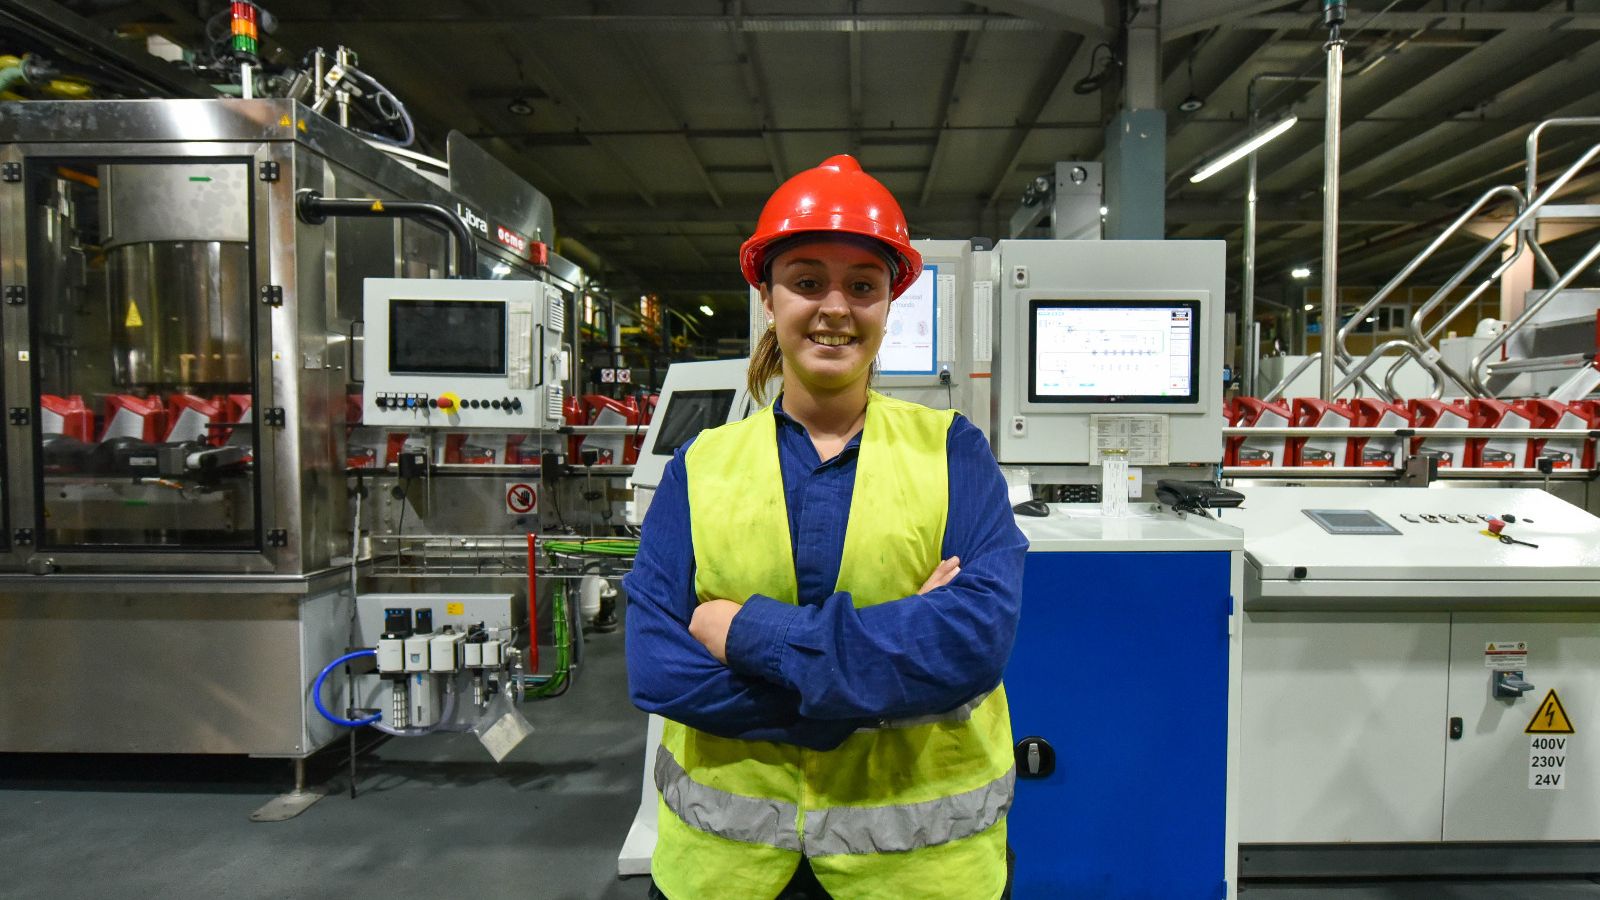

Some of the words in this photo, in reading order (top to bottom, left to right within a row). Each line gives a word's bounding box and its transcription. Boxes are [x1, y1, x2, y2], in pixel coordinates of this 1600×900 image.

[457, 203, 488, 233] Libra
[498, 228, 524, 251] ocme
[1532, 738, 1566, 750] 400V
[1531, 756, 1565, 768] 230V
[1535, 774, 1561, 786] 24V
